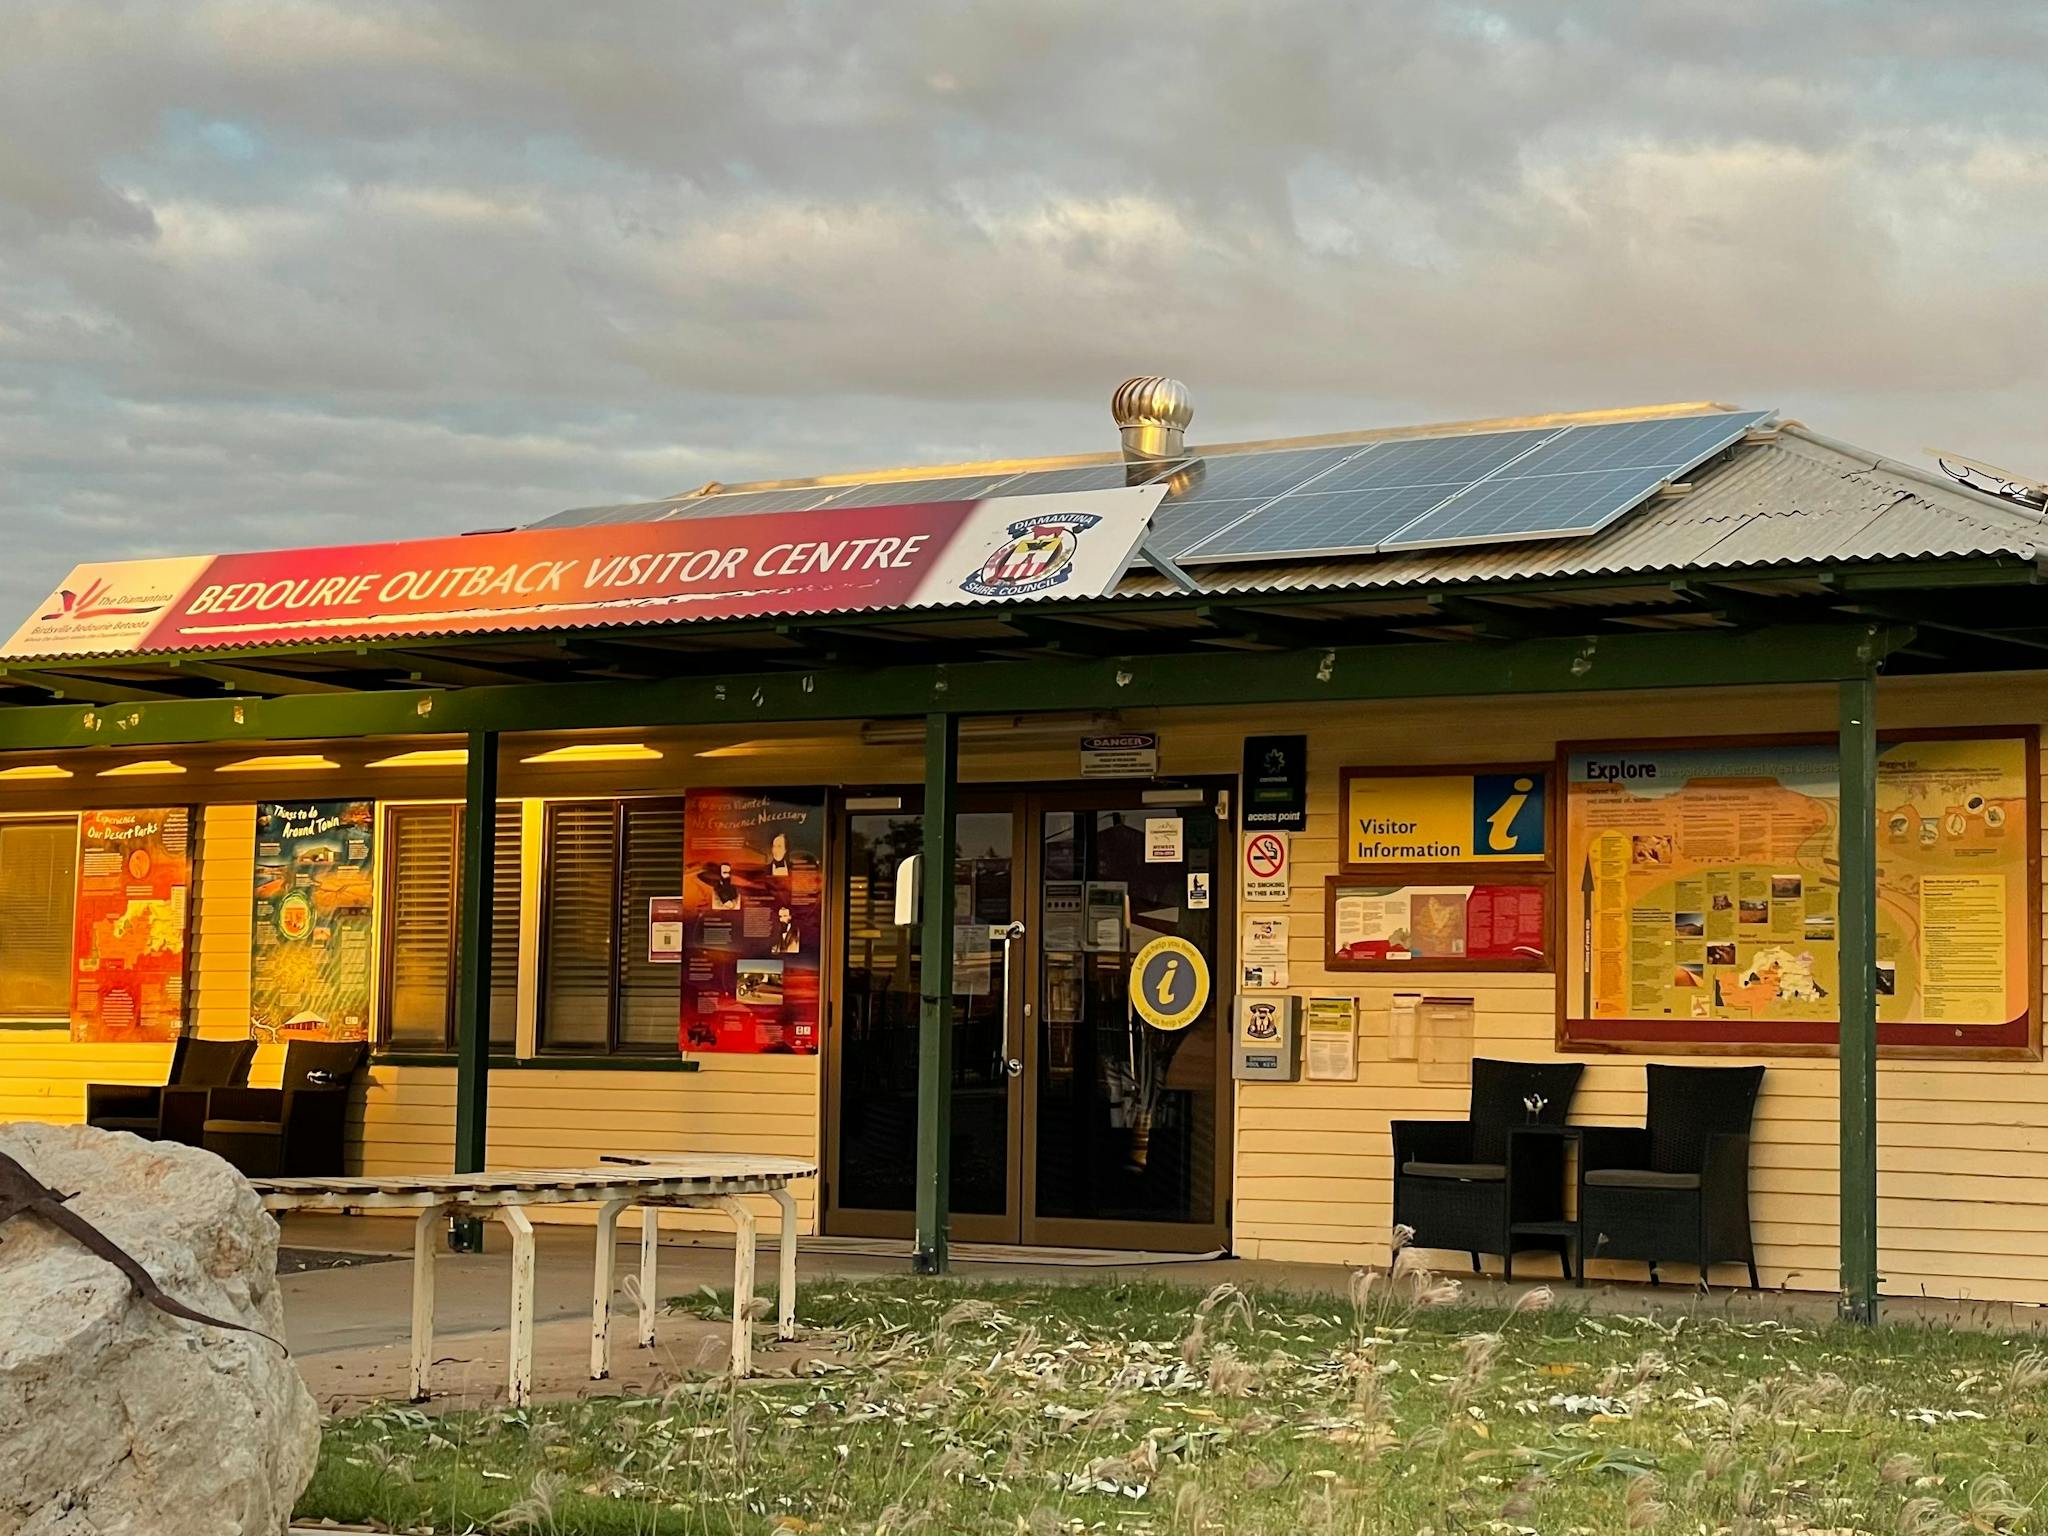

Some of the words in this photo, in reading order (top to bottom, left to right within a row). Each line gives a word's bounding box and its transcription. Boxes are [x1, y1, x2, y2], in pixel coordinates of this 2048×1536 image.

[1014, 513, 1094, 530] DIAMANTINA
[185, 574, 382, 616] BEDOURIE
[378, 559, 579, 603] OUTBACK
[583, 547, 749, 589] VISITOR
[752, 534, 930, 577] CENTRE
[965, 581, 997, 595] SHIRE
[998, 577, 1059, 595] COUNCIL
[98, 596, 115, 606] The
[117, 593, 174, 605] Diamantina
[1093, 737, 1142, 746] DANGER
[1586, 760, 1657, 783] Explore
[95, 812, 136, 826] Experience
[273, 804, 297, 820] Things
[298, 809, 307, 820] to
[308, 805, 318, 819] do
[758, 808, 807, 825] Necessary
[1247, 813, 1277, 822] access
[1277, 811, 1301, 823] point
[1359, 818, 1417, 834] Visitor
[1486, 778, 1534, 851] i
[87, 826, 104, 840] Our
[104, 826, 134, 840] Desert
[134, 822, 158, 837] Parks
[282, 819, 315, 839] Around
[315, 816, 340, 833] Town
[1358, 841, 1461, 858] Information
[1150, 941, 1166, 950] help
